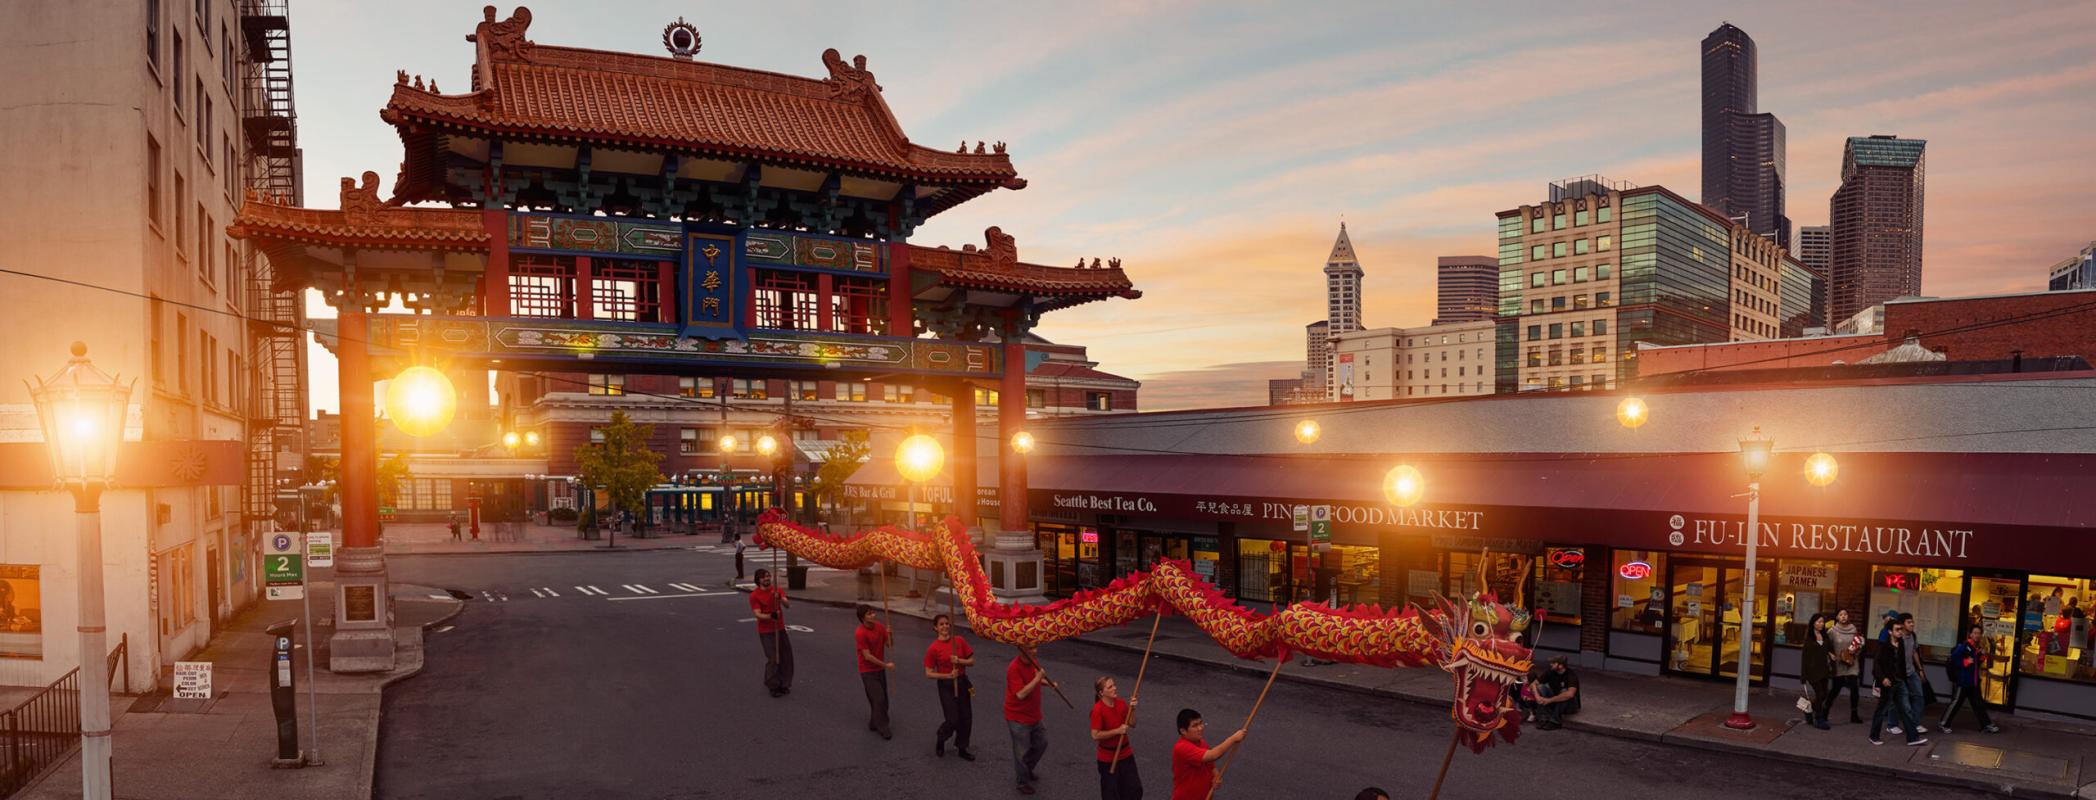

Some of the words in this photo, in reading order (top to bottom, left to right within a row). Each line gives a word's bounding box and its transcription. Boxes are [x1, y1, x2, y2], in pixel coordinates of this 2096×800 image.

[701, 243, 721, 317] 中華門
[859, 486, 871, 498] Bar
[872, 487, 879, 499] &
[879, 487, 896, 499] Grill
[976, 488, 997, 496] orean
[1053, 494, 1088, 509] Seattle
[1089, 495, 1113, 510] Best
[1114, 496, 1135, 511] Tea
[1137, 497, 1157, 512] Co.
[1262, 502, 1293, 520] PIN
[1386, 508, 1484, 530] MARKET
[1317, 522, 1325, 533] 2
[1789, 522, 1974, 559] RESTAURANT
[277, 556, 289, 572] 2
[1620, 563, 1651, 578] OPEN
[1785, 565, 1828, 578] JAPANESE
[1788, 576, 1818, 587] RAMEN
